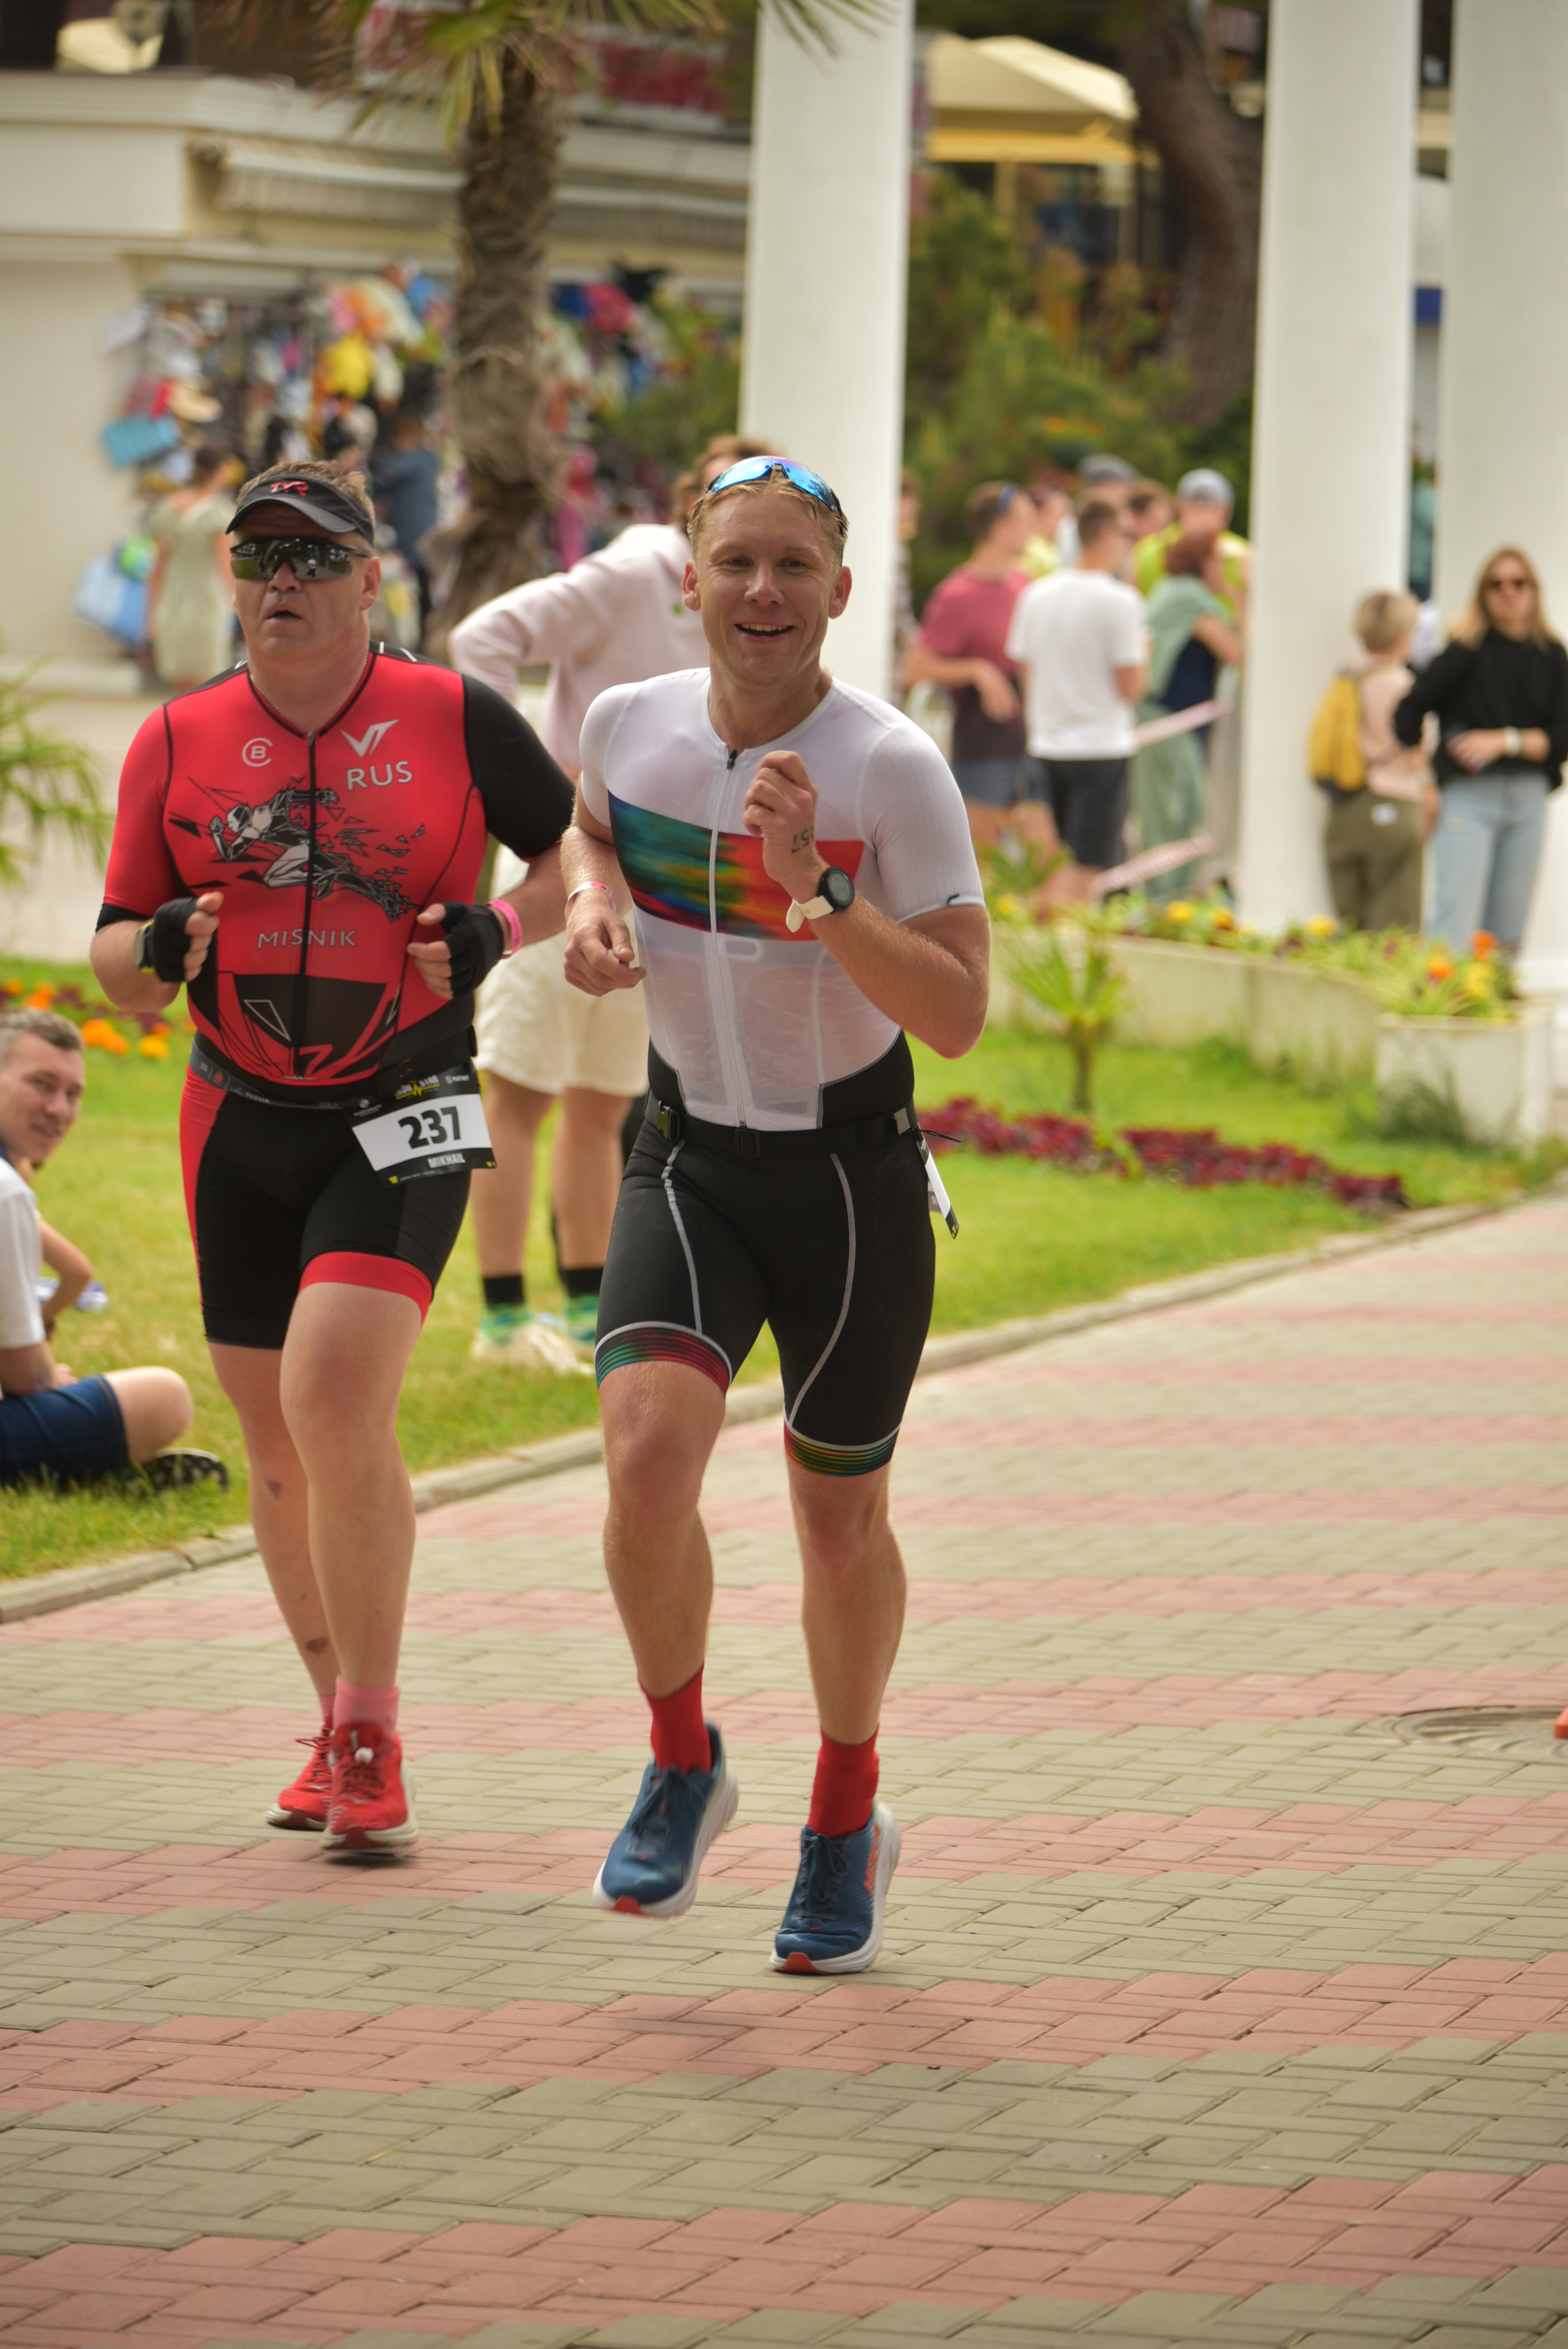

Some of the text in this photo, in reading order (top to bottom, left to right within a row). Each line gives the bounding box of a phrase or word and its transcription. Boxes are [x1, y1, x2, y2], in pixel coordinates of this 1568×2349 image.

[270, 481, 309, 496] TYR
[347, 760, 413, 791] RUS
[257, 928, 357, 949] MISNIK
[418, 1075, 439, 1088] STAR
[398, 1106, 462, 1149] 237
[427, 1152, 466, 1169] MIKHAIL
